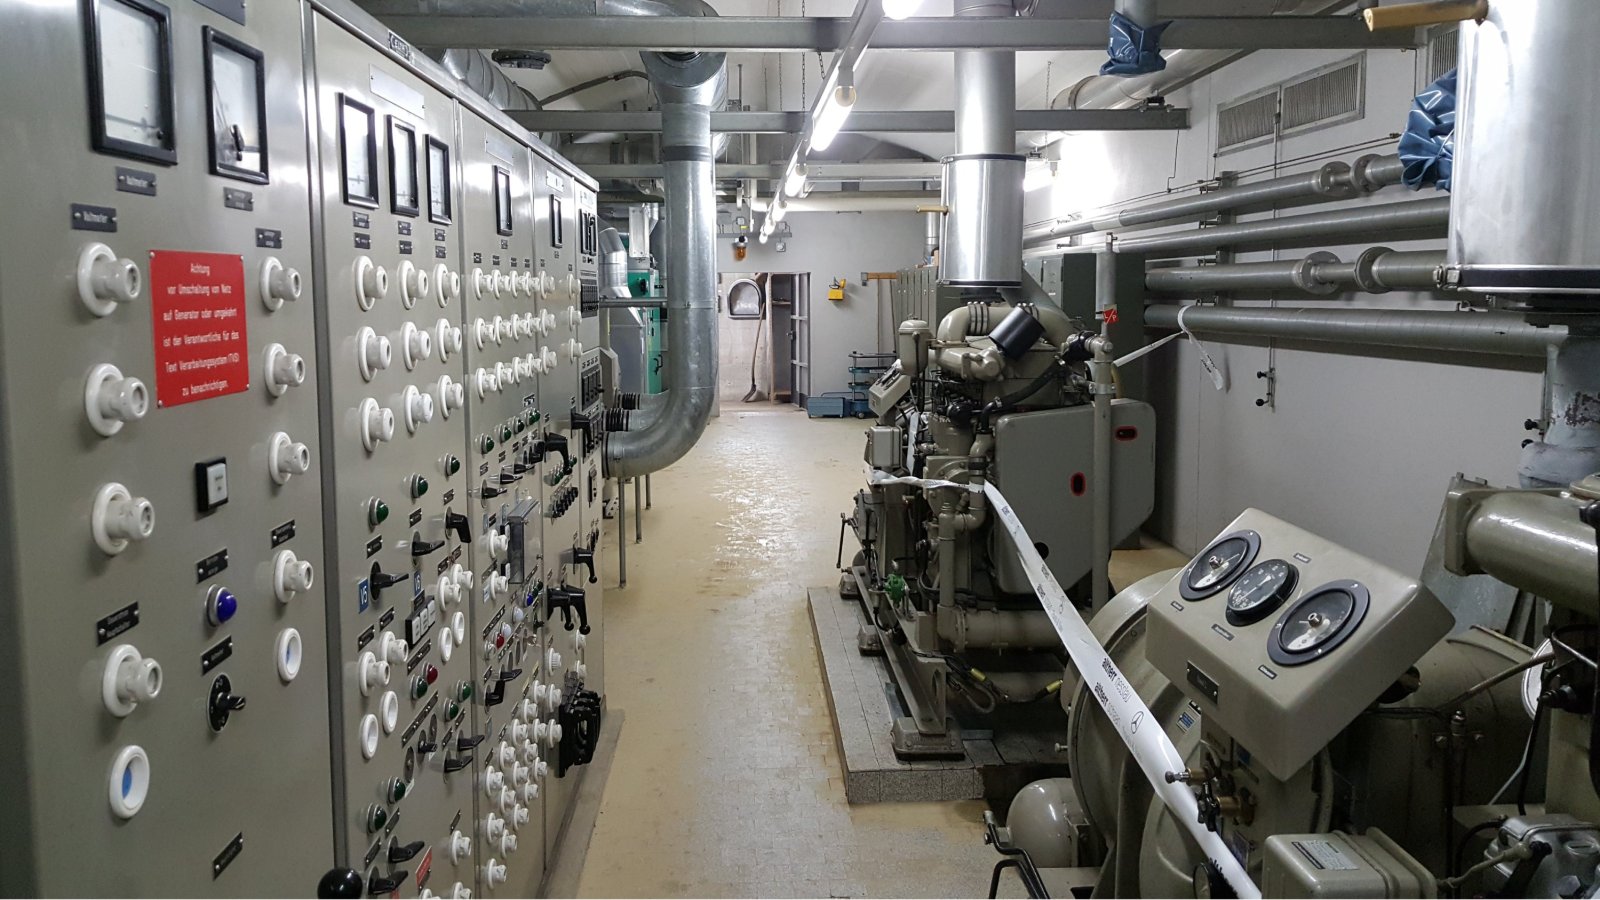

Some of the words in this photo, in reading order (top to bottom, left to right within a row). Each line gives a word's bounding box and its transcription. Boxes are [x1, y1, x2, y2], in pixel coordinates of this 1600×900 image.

[83, 210, 109, 224] Voltmeter
[190, 264, 210, 275] Achtung
[168, 286, 176, 294] vor
[178, 284, 210, 295] Umschaltung
[222, 284, 232, 293] Netz
[164, 310, 173, 320] auf
[174, 310, 200, 319] Generator
[202, 309, 213, 318] oder
[214, 308, 237, 318] umgekehrt
[184, 332, 222, 344] Verantwortliche
[232, 331, 240, 340] das
[166, 362, 177, 372] Text
[180, 356, 227, 369] Verarbeitungssystem
[182, 387, 189, 396] zu
[360, 585, 368, 605] V5
